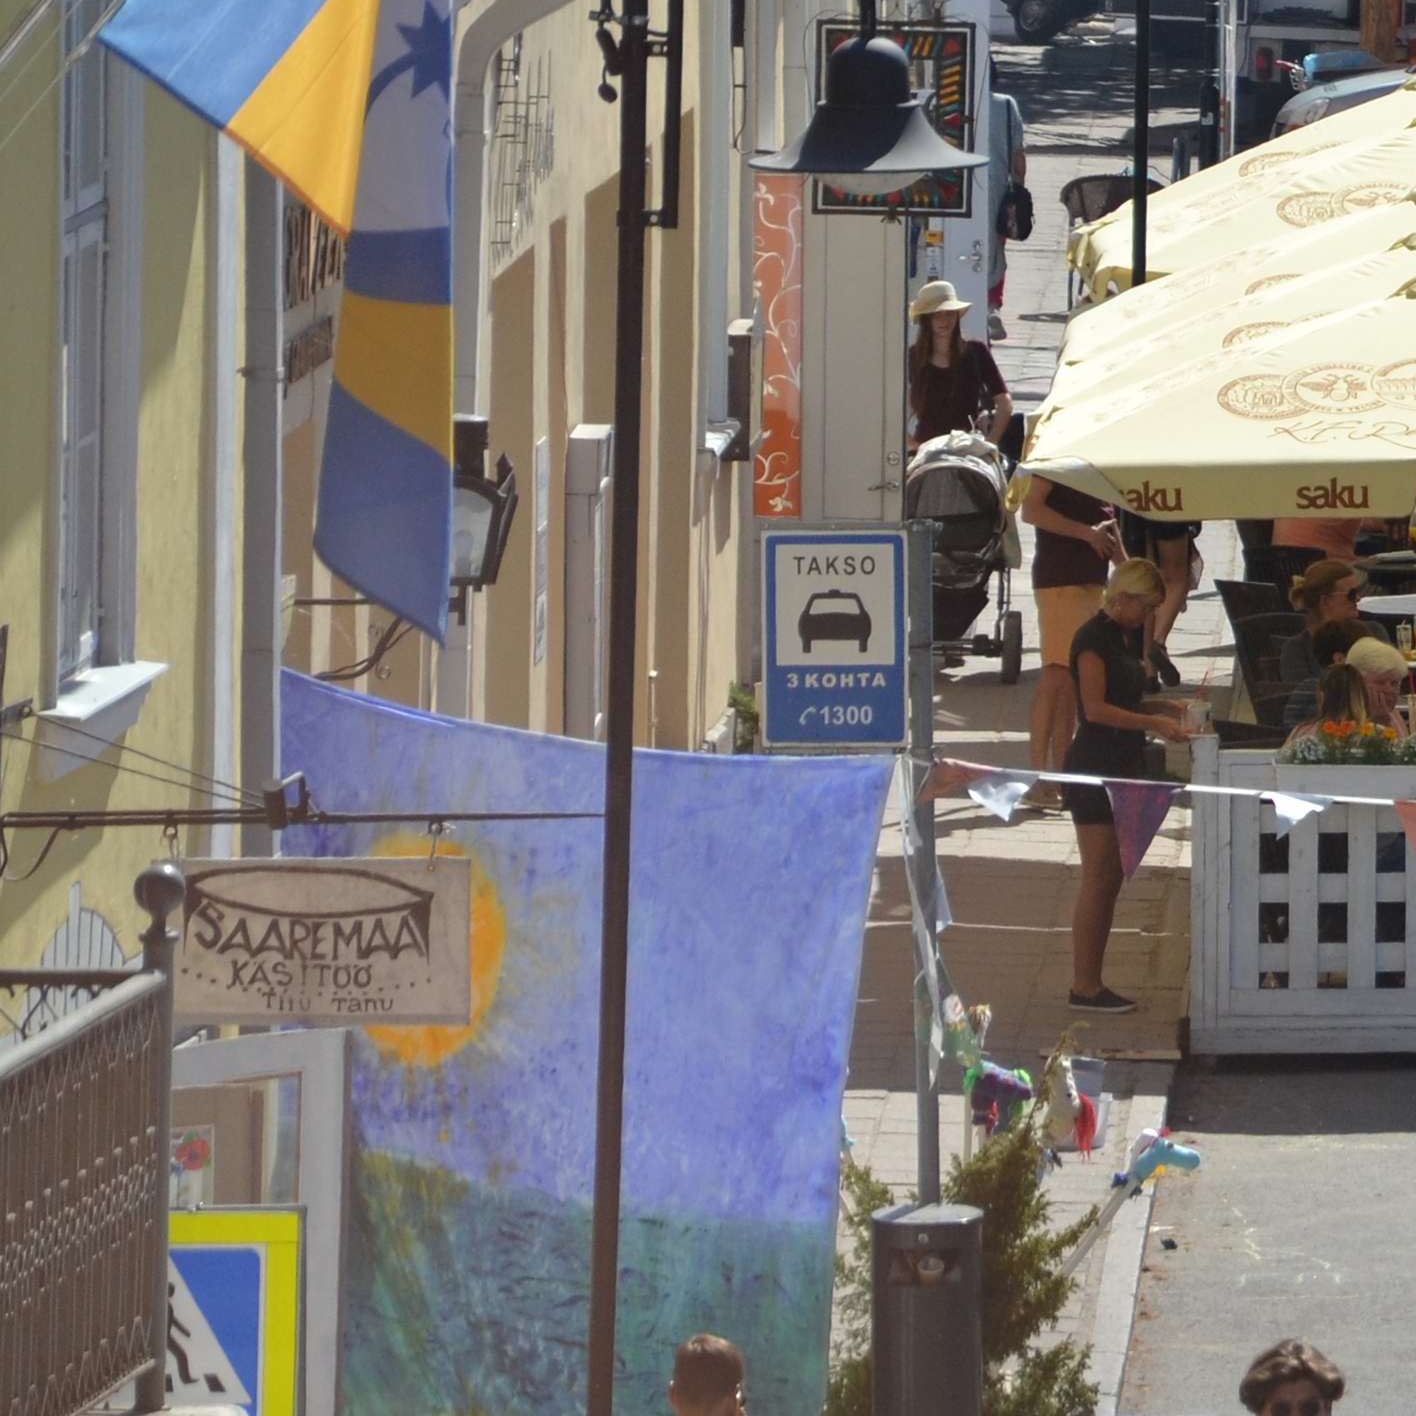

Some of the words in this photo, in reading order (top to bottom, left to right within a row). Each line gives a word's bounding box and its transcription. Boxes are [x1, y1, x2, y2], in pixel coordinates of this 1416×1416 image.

[1119, 481, 1184, 512] aku
[1296, 477, 1370, 510] saku
[793, 556, 876, 575] TAKSO
[787, 672, 799, 688] 3
[804, 672, 887, 688] KOHTA
[819, 705, 873, 726] 1300
[193, 897, 426, 961] SAAREMAA
